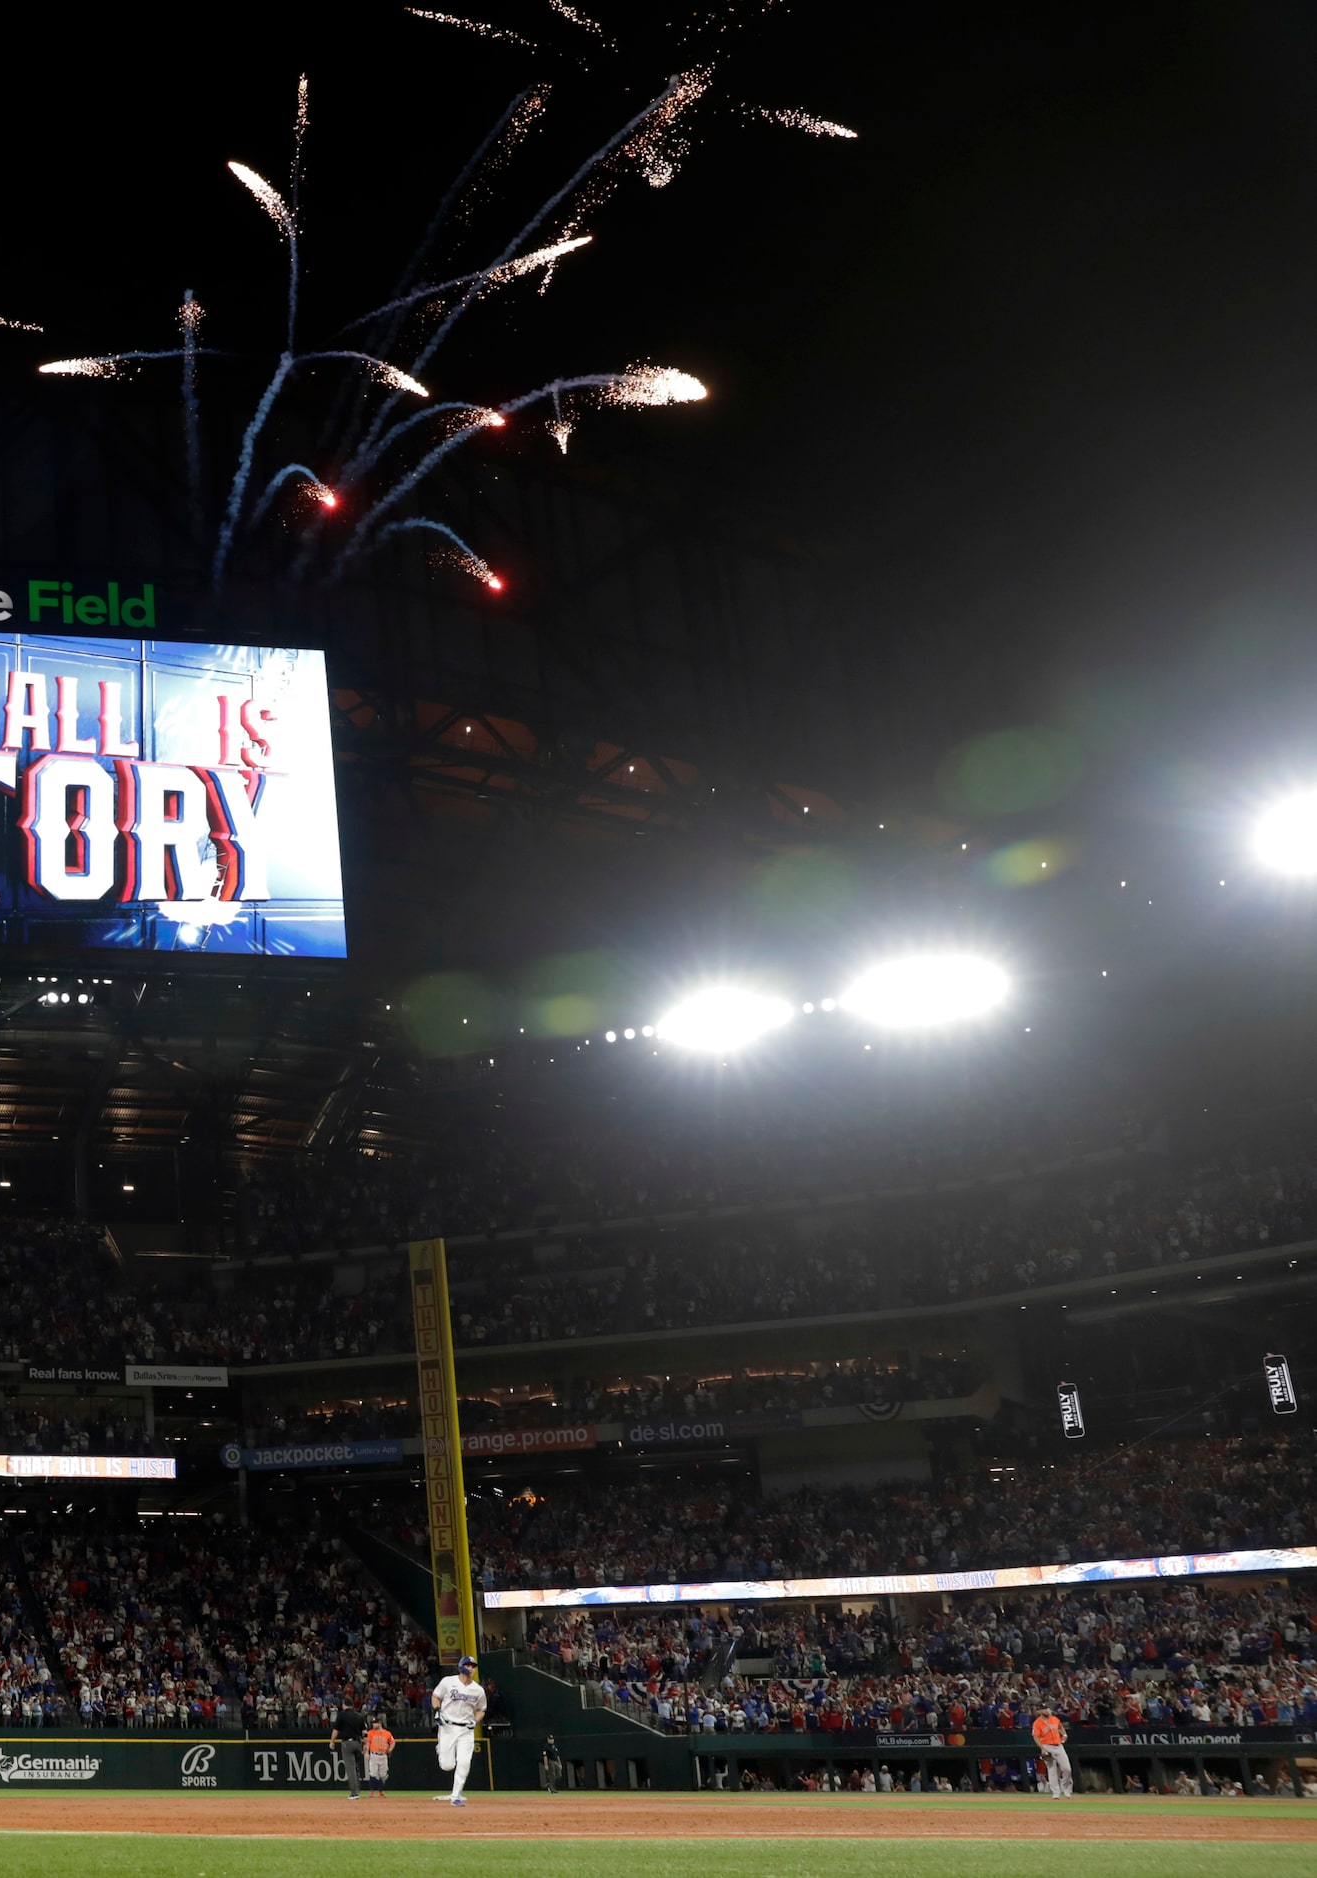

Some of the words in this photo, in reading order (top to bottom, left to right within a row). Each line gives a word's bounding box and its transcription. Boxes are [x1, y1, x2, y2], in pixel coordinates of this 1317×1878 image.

[28, 580, 156, 629] Field
[217, 695, 278, 770] IS
[29, 1367, 55, 1380] Real
[57, 1367, 83, 1380] fans
[85, 1368, 120, 1381] know.
[1266, 1365, 1285, 1405] TRULY
[1059, 1393, 1075, 1430] TRULY
[10, 1457, 53, 1474] THAT
[59, 1457, 101, 1475] BALL
[105, 1458, 123, 1475] IS
[834, 1578, 870, 1593] THAT
[876, 1576, 910, 1592] BALL
[916, 1575, 930, 1590] IS
[935, 1571, 997, 1590] HISTORY
[1135, 1734, 1170, 1745] ALCS
[18, 1754, 100, 1770] Germania
[23, 1771, 86, 1779] INSURANCE
[182, 1776, 217, 1787] SPORTS
